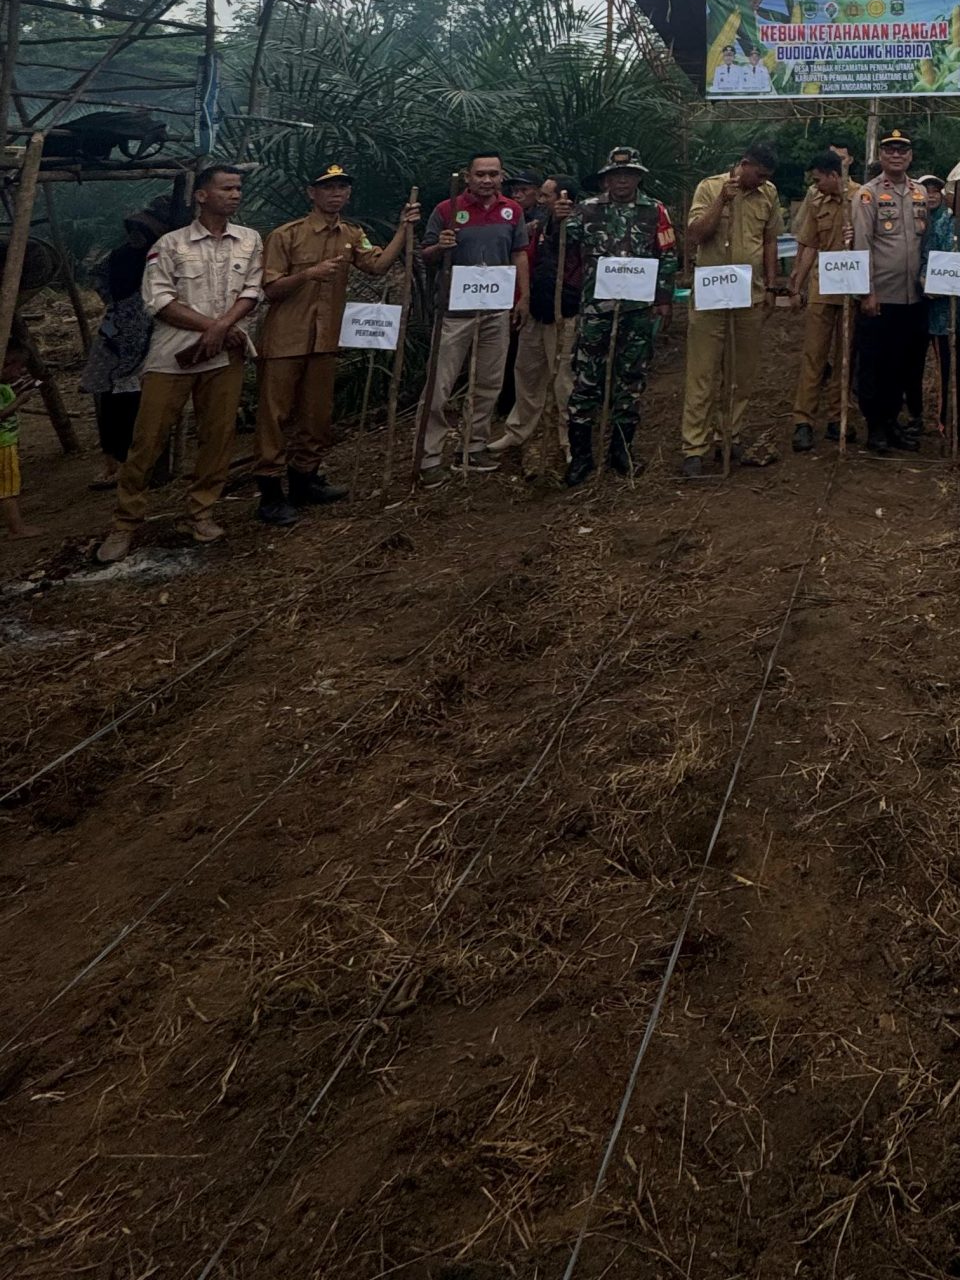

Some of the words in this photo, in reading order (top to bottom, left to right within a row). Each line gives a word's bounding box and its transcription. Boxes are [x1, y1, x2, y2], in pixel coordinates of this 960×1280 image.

[760, 24, 806, 42] KEBUN
[809, 23, 889, 41] KETAHANAN
[892, 22, 948, 40] PANGAN
[777, 45, 834, 60] BUDIDAYA
[836, 44, 882, 59] JAGUNG
[884, 43, 932, 59] HIBRIDA
[795, 64, 809, 72] DESA
[834, 64, 868, 72] KECAMATAN
[869, 63, 895, 71] PENUKAL
[795, 73, 828, 82] KABUPATEN
[829, 73, 854, 81] PENUKAL
[821, 83, 841, 91] TAHUN
[873, 82, 888, 90] 2025
[604, 265, 646, 275] BABINSA
[824, 260, 861, 272] CAMAT
[702, 273, 738, 287] DPMD
[462, 283, 500, 294] P3MD
